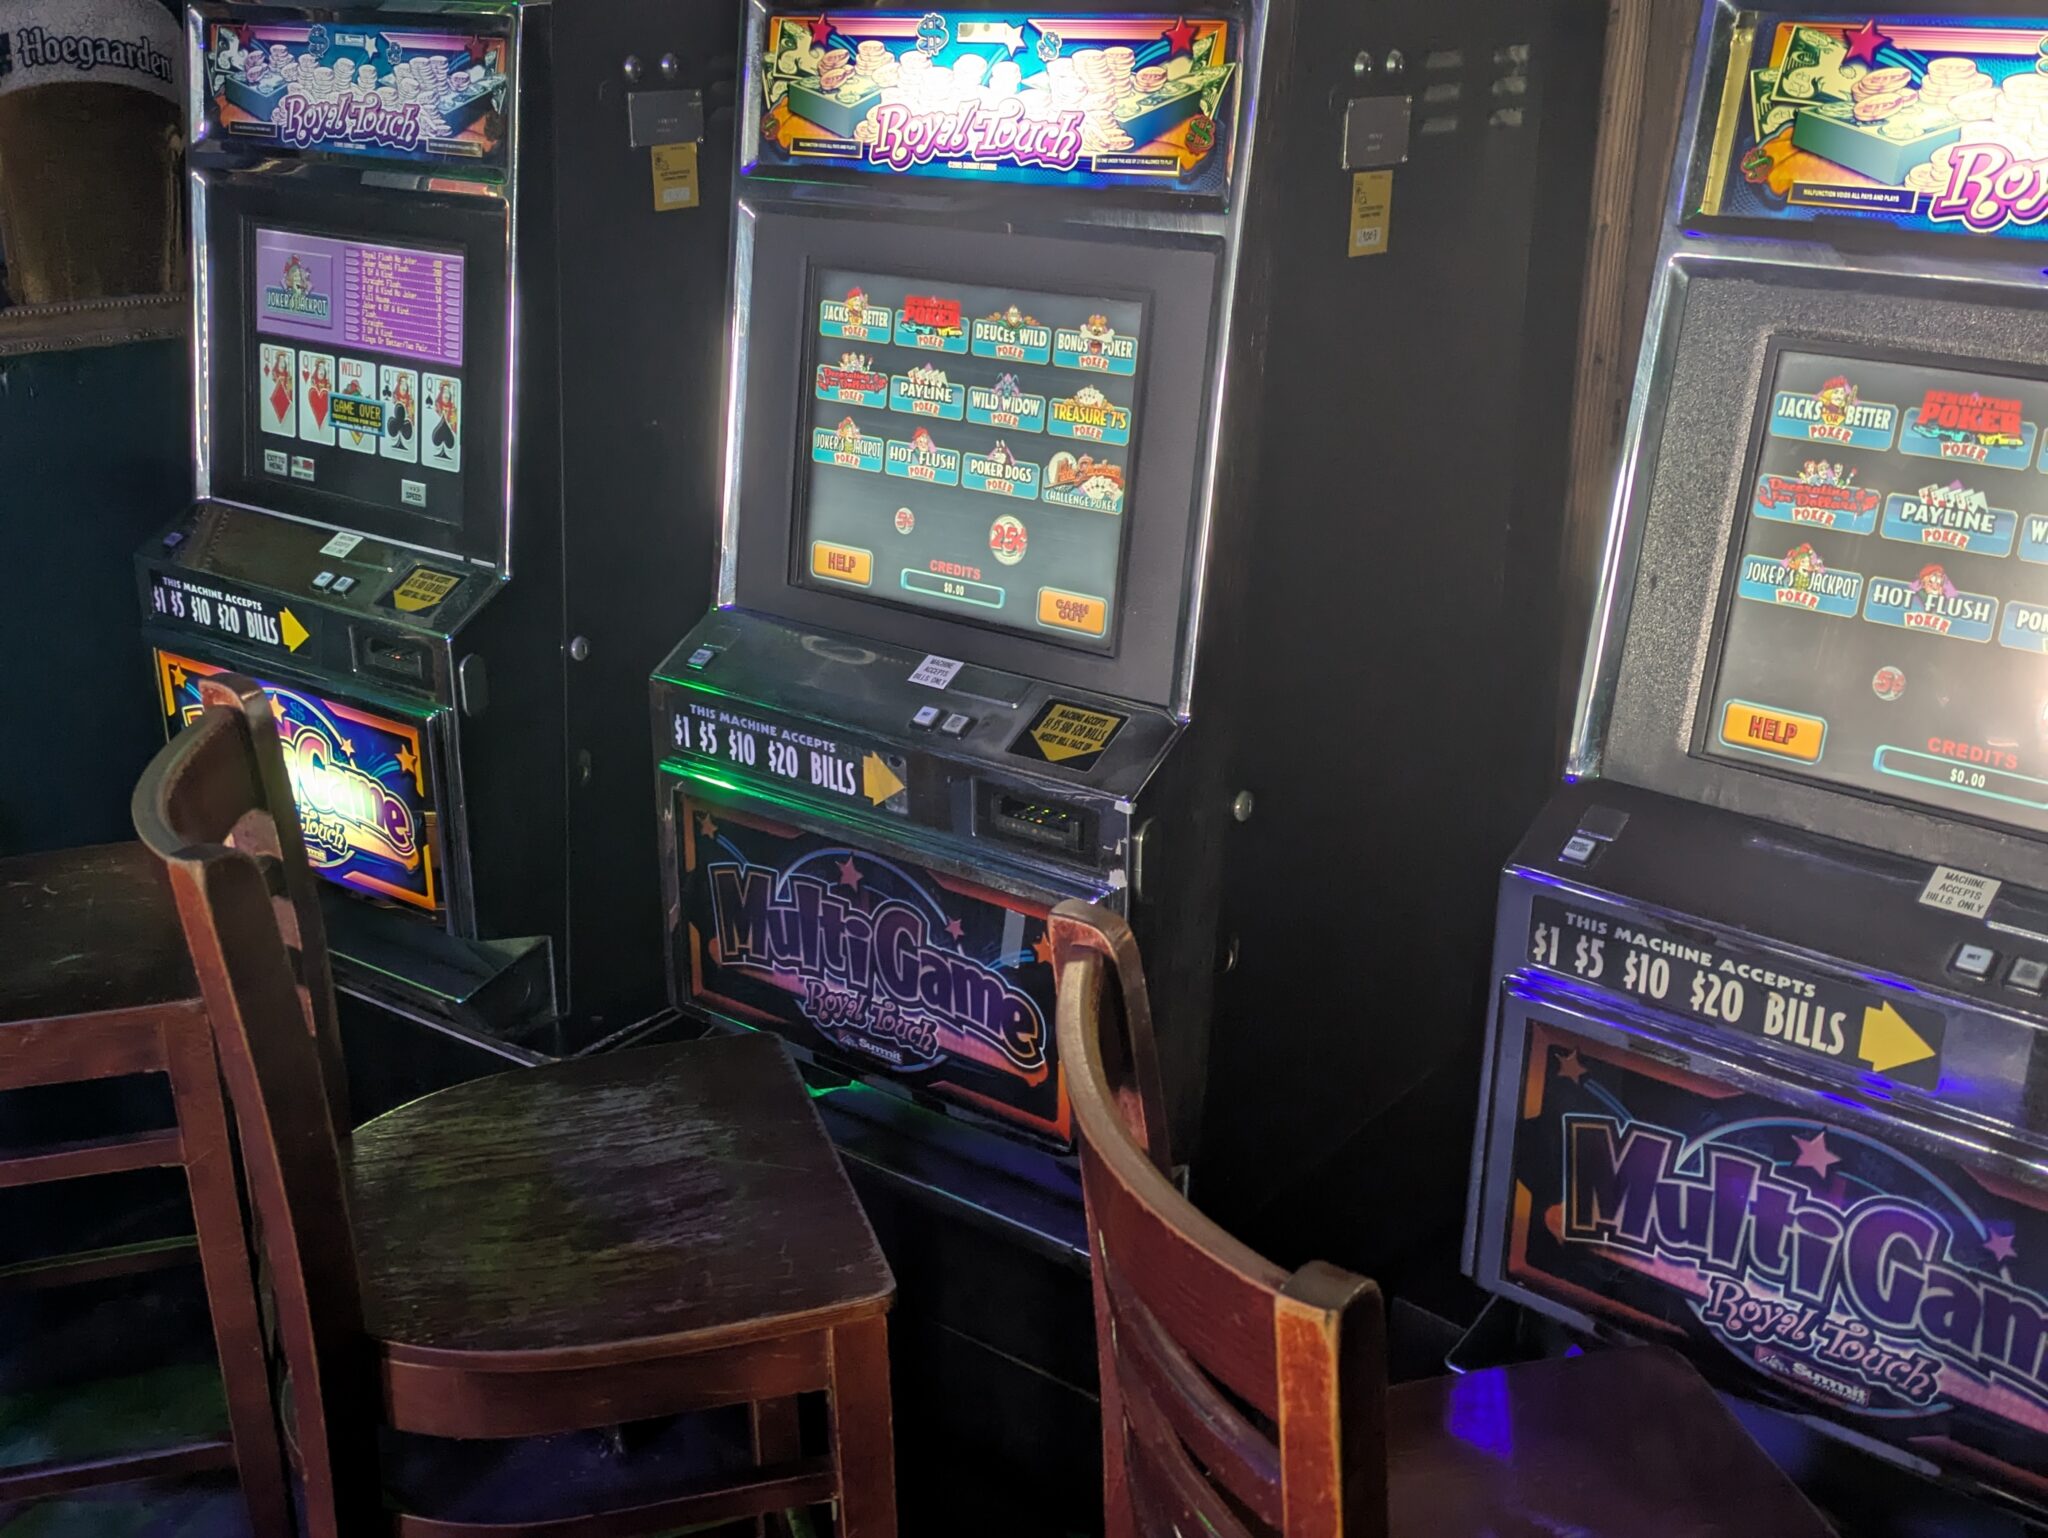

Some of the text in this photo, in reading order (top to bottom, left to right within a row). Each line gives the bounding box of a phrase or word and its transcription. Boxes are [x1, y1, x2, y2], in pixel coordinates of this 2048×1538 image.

[17, 26, 173, 83] Hoegaarden
[284, 94, 418, 146] Royal Touch
[874, 99, 1085, 164] Royal Touch
[1803, 189, 1836, 198] MALFUNCTION
[1935, 146, 2048, 222] Roy
[824, 305, 848, 322] JACKS
[863, 310, 888, 327] BETTER
[844, 327, 866, 337] POKER
[919, 336, 943, 347] POKER
[976, 322, 1047, 347] DEUCES WILD
[997, 346, 1024, 358] POKER
[1058, 335, 1132, 358] BONUS POKER
[341, 363, 362, 378] WILD
[1080, 356, 1108, 370] POKER
[840, 390, 863, 402] POKER
[900, 383, 952, 403] PAYLINE
[972, 391, 1040, 416] WILD WIDOW
[334, 399, 354, 415] GAME
[360, 404, 381, 420] OVER
[913, 402, 940, 415] POKER
[1053, 403, 1106, 426] TREASURE
[1778, 396, 1822, 420] JACKS
[1845, 405, 1892, 430] BETTER
[1918, 402, 2020, 434] POKER
[992, 414, 1018, 426] POKER
[1074, 426, 1102, 439] POKER
[1810, 426, 1852, 444] POKER
[816, 433, 882, 458] JOKER'S JACKPOT
[1943, 444, 1987, 462] POKER
[836, 454, 859, 466] POKER
[890, 447, 956, 470] HOT FLUSH
[910, 466, 934, 480] POKER
[970, 460, 1032, 482] POKER DOGS
[986, 480, 1013, 493] POKER
[1046, 490, 1117, 512] CHALLENGE POKER
[1794, 508, 1836, 526] POKER
[1901, 502, 1996, 533] PAYLINE
[1923, 529, 1967, 548] POKER
[828, 552, 856, 573] HELP
[930, 560, 982, 580] CREDITS
[944, 583, 964, 596] $0.00
[1746, 562, 1859, 598] JOKER'S JACKPOT
[162, 576, 262, 611] THIS MACHINE ACCEPTS
[1777, 590, 1818, 608] POKER
[1873, 584, 1990, 622] HOT FLUSH
[154, 586, 279, 645] $1 $5 $10 $20 BILLS
[1056, 598, 1090, 615] CASH
[1058, 610, 1084, 623] OUT
[1906, 614, 1949, 632] POKER
[930, 676, 947, 686] ONLY
[690, 704, 836, 753] THIS MACHINE ACCEPTS
[1058, 710, 1108, 727] MACHINE ACCEPTS
[1056, 736, 1070, 746] BILL
[1072, 724, 1087, 736] $20
[1084, 727, 1108, 741] BILLS
[1748, 716, 1798, 745] HELP
[674, 714, 856, 796] $1 $5 $10 $20 BILLS
[1928, 736, 2018, 770] CREDITS
[1950, 768, 1986, 788] $0.00
[1944, 872, 1986, 888] MACHINE
[1926, 892, 1984, 912] BILLS ONLY
[1940, 883, 1982, 900] ACCEPTS
[711, 865, 1042, 1063] MultiGame
[1565, 912, 1816, 998] THIS MACHINE ACCEPTS
[1533, 922, 1847, 1055] $1 $5 $10 $20 BILLS
[807, 979, 936, 1051] Royal Touch
[859, 1038, 902, 1061] Summit
[1567, 1119, 2048, 1393] MultiGam
[1708, 1277, 1930, 1396] Royal Touch
[1792, 1362, 1866, 1404] Summit
